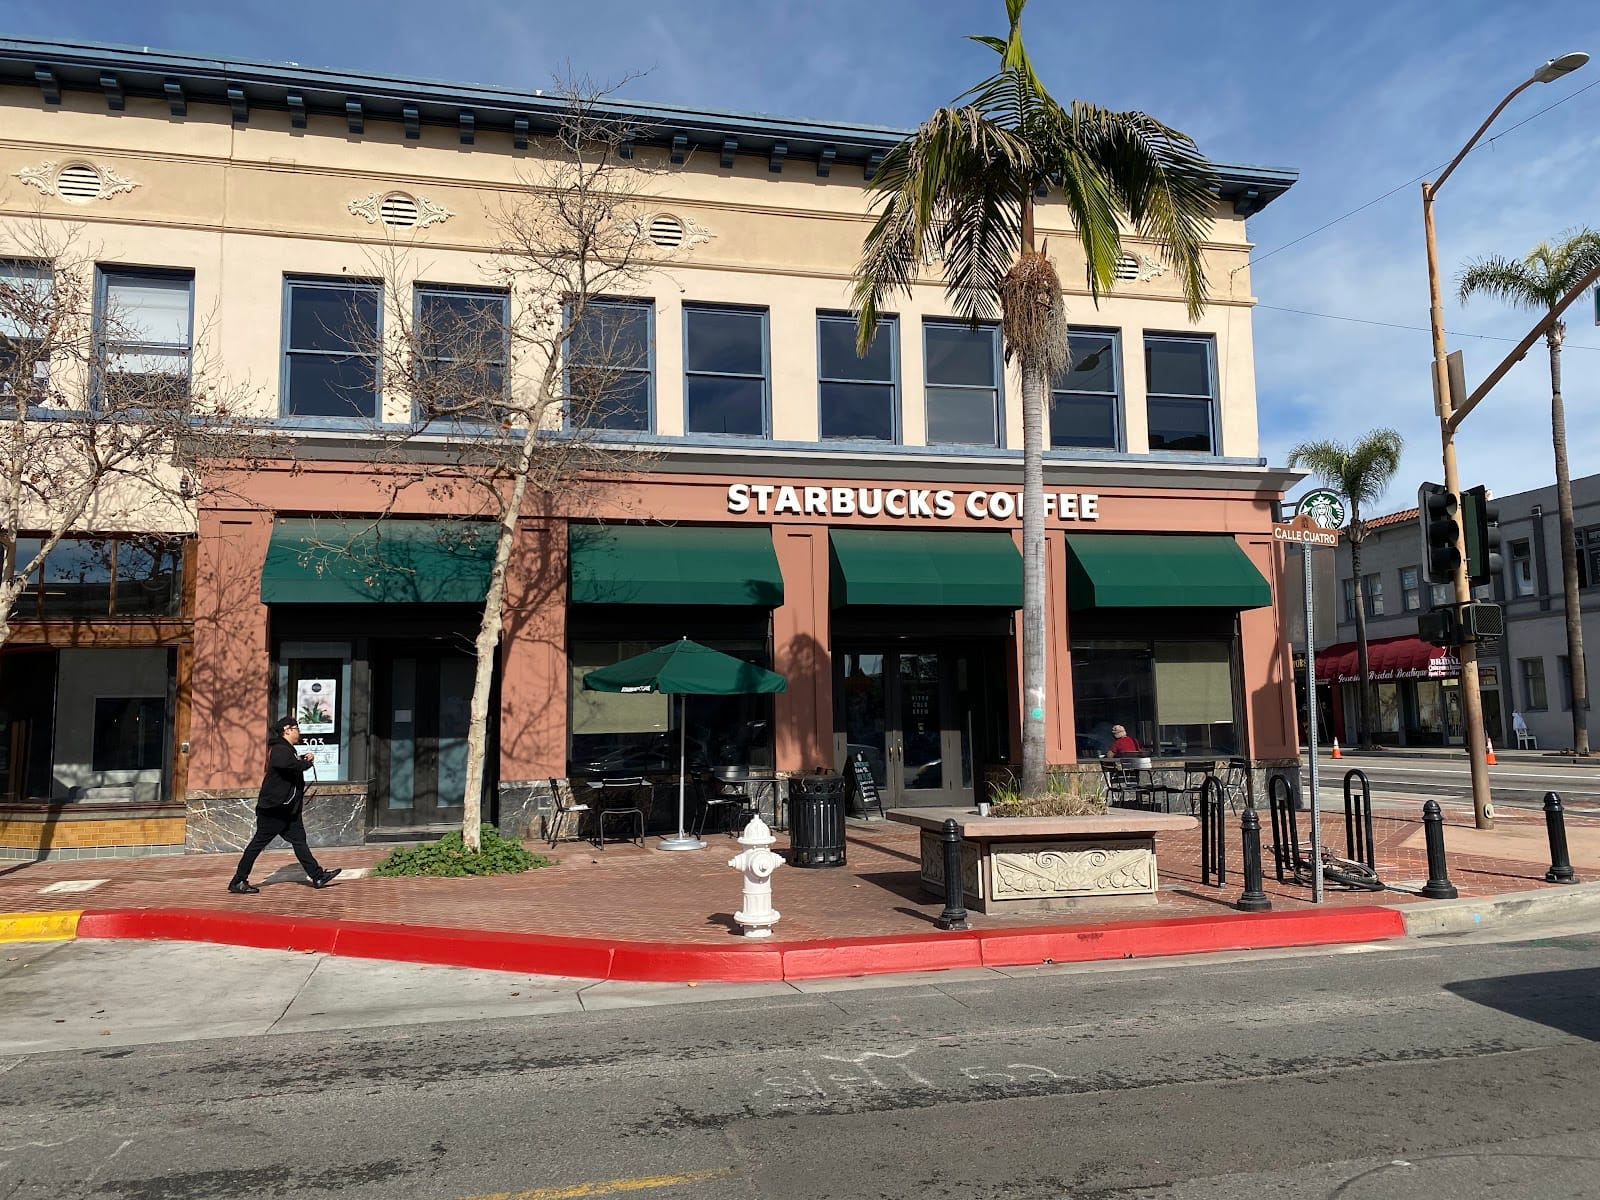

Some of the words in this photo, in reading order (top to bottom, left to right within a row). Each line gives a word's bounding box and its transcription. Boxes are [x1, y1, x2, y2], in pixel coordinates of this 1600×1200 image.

[727, 484, 956, 518] STARBUCKS
[1275, 528, 1301, 540] CALLE
[1304, 530, 1335, 543] CUATRO
[1429, 658, 1461, 666] BRIDAL
[1368, 669, 1394, 681] Bridal
[303, 738, 325, 751] 303
